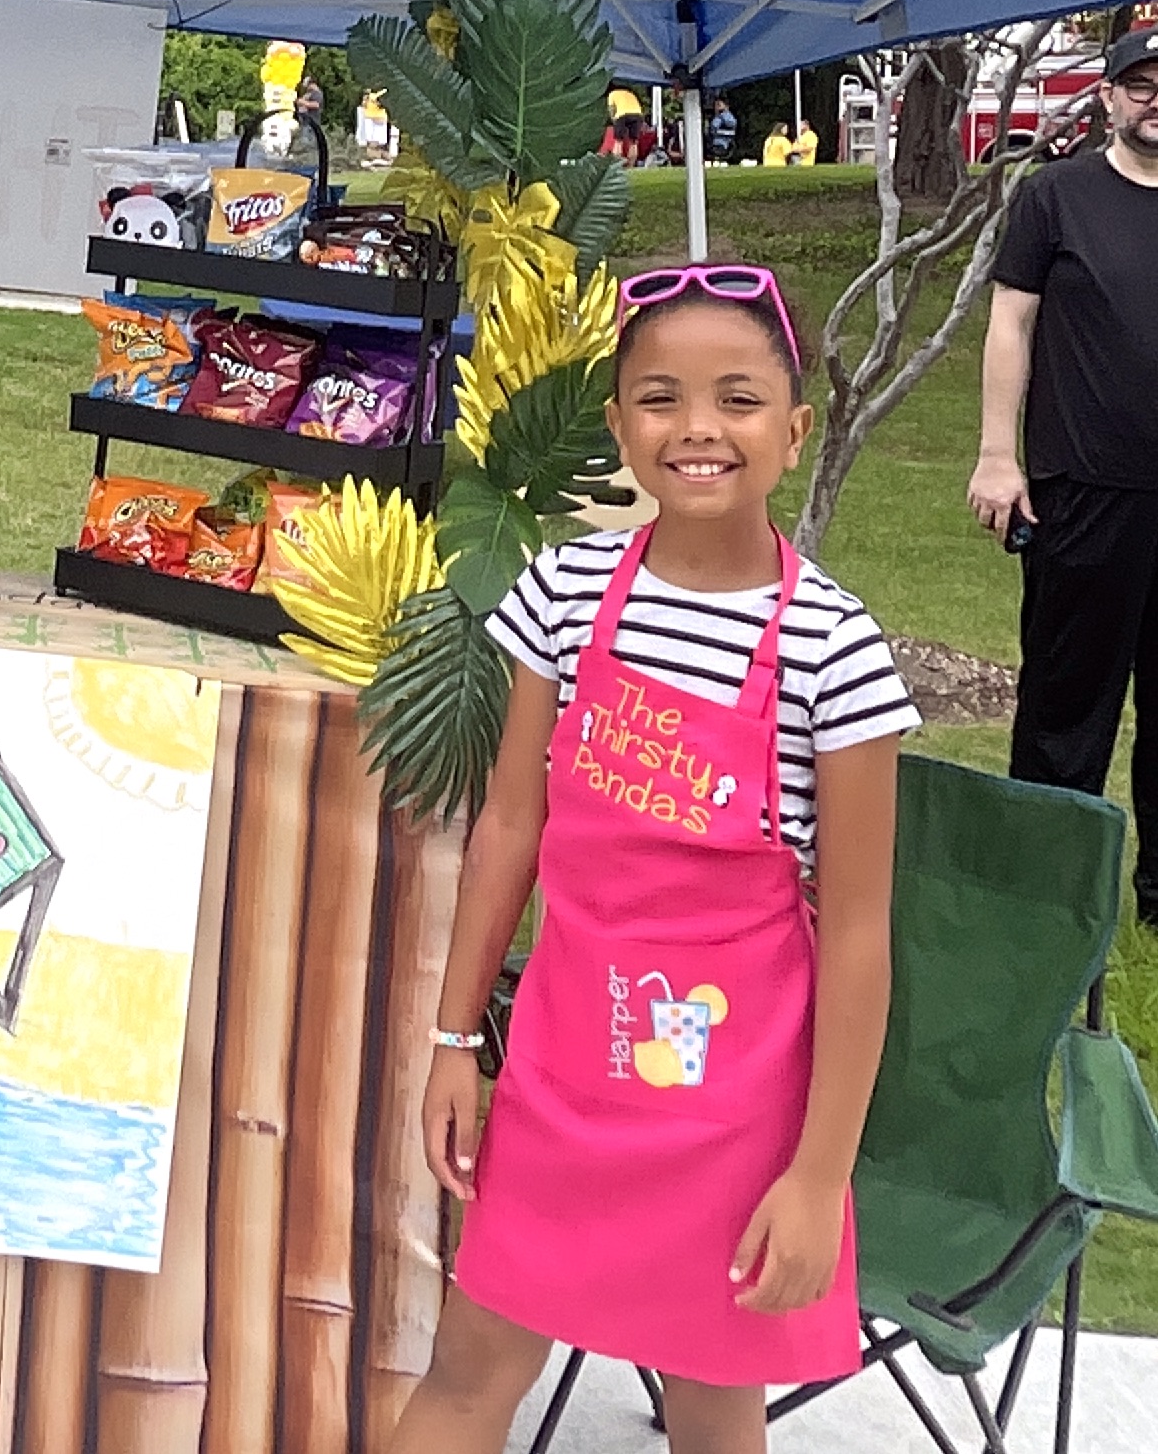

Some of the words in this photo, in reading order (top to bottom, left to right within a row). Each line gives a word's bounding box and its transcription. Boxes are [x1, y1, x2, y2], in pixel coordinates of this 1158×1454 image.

[223, 196, 285, 232] Fritos
[591, 702, 713, 800] Thirsty
[616, 677, 682, 735] The
[571, 743, 712, 834] Pandas
[607, 964, 637, 1079] Harper
